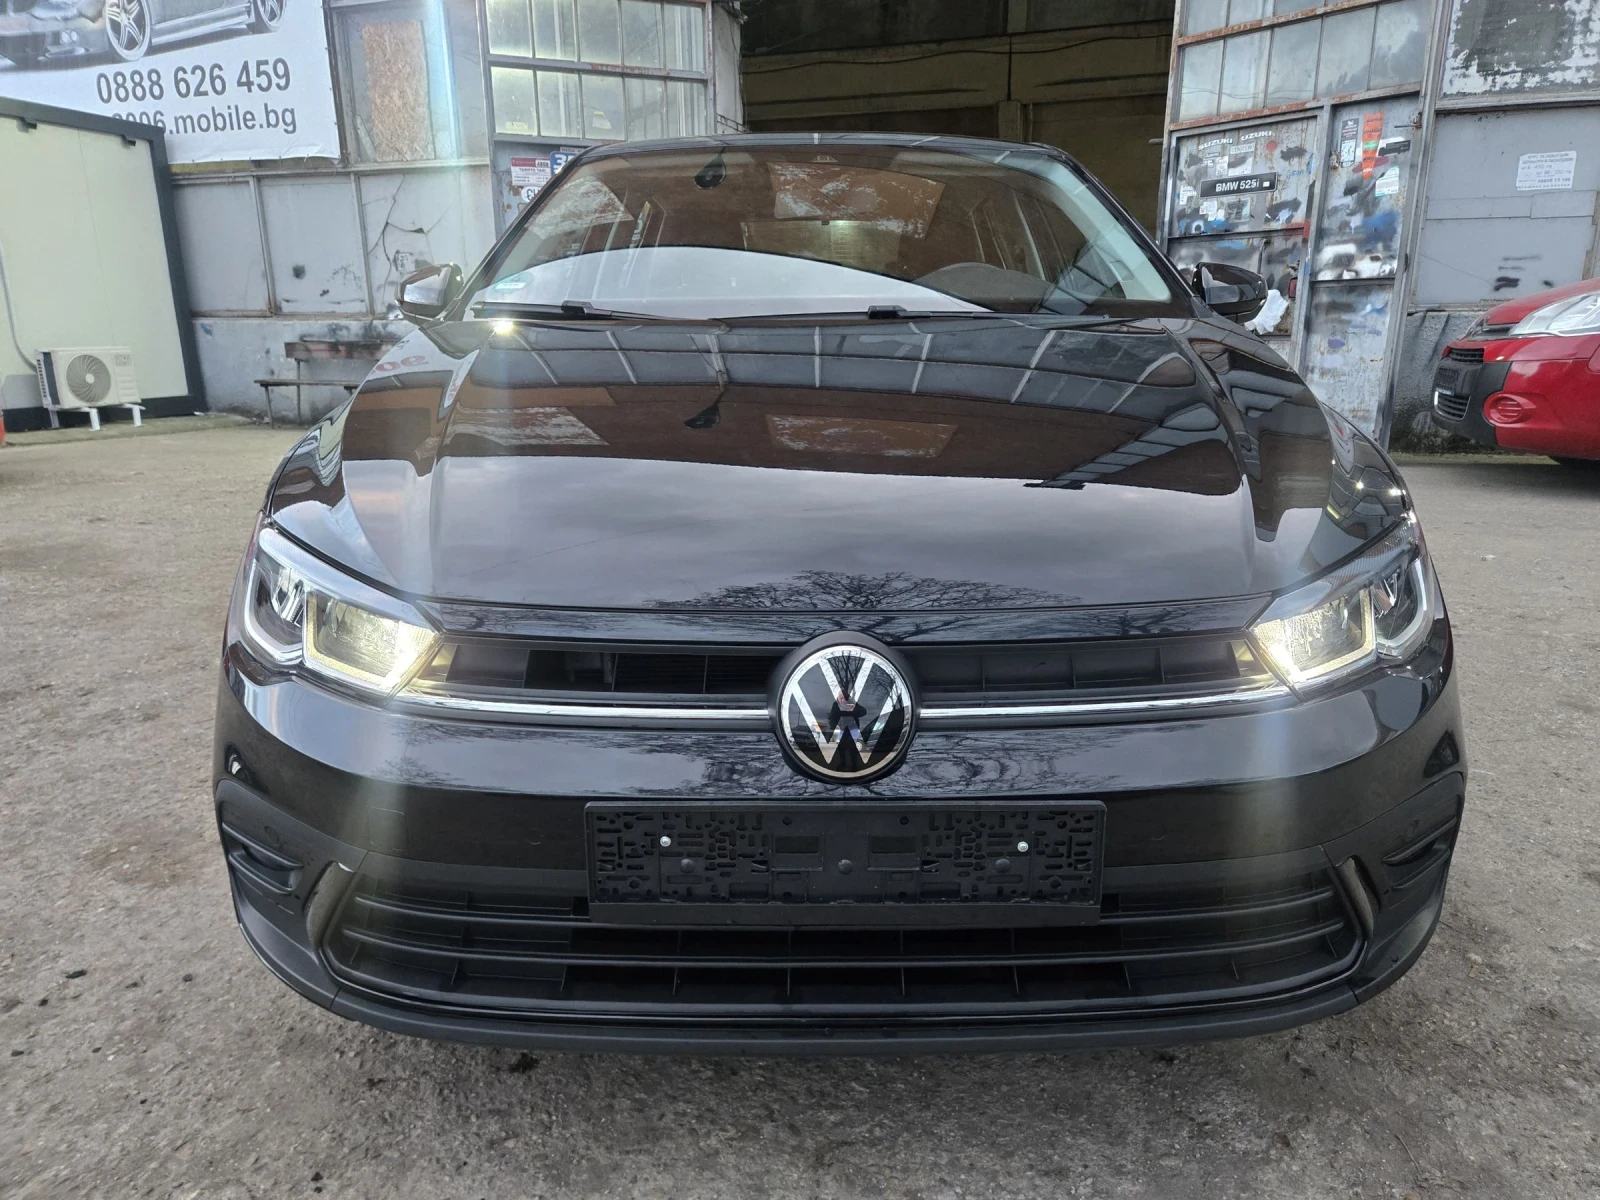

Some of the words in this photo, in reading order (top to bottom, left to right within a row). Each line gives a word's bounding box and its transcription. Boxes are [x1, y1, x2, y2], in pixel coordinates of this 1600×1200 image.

[96, 68, 165, 104] 0888
[173, 63, 227, 98] 626
[236, 57, 291, 94] 459
[1198, 138, 1233, 151] SUZUKI
[1215, 181, 1239, 193] BMW
[1239, 179, 1260, 189] 525i
